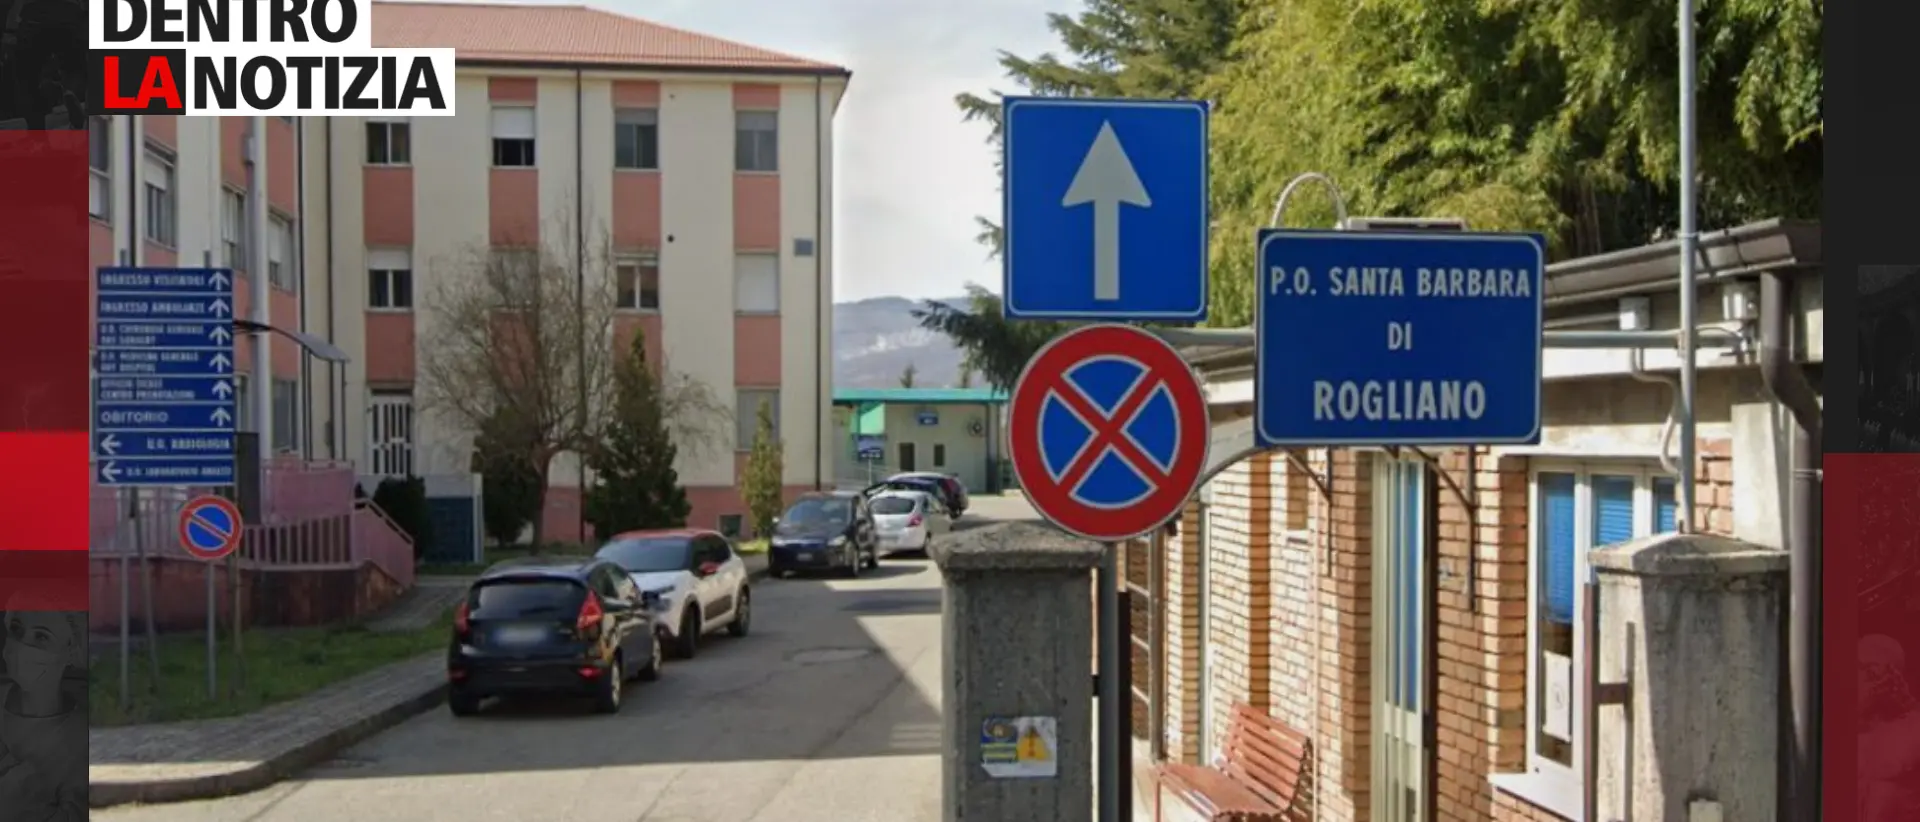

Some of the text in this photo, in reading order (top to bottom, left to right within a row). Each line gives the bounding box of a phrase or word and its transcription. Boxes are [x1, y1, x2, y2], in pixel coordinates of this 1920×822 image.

[1270, 267, 1530, 297] P.O. SANTA BARBARA
[1387, 321, 1412, 350] DI
[1313, 380, 1486, 420] ROGLIANO
[101, 411, 168, 423] OBITORIO
